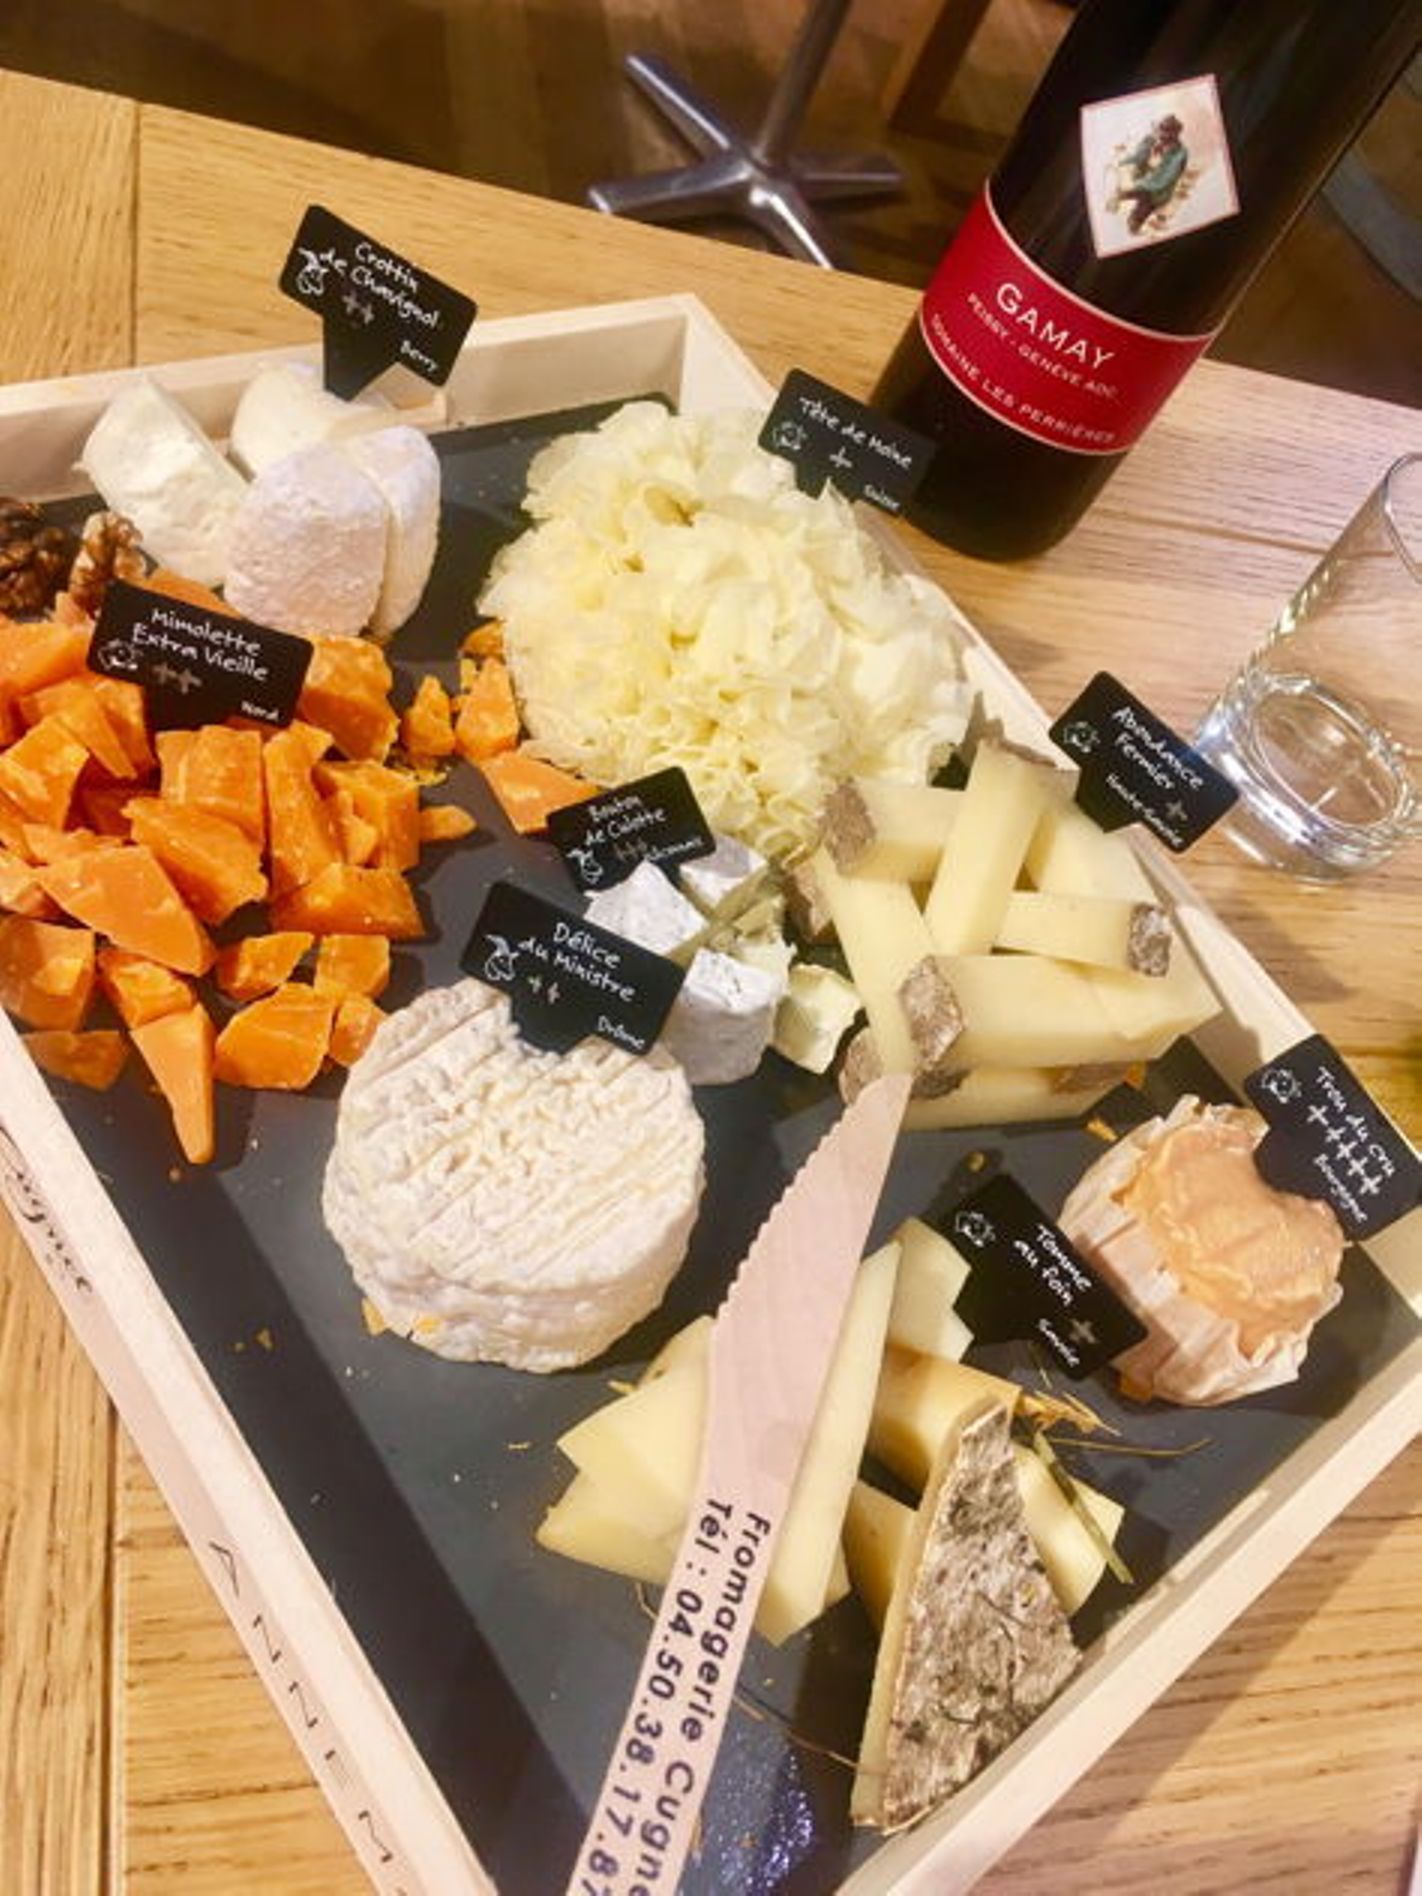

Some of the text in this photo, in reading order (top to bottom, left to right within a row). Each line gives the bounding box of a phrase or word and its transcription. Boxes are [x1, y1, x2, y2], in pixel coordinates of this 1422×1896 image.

[930, 312, 980, 382] DOMAINE
[981, 378, 1017, 409] LES
[997, 282, 1115, 370] GAMAY
[132, 622, 269, 682] Extra Vieille
[152, 608, 262, 657] Mimolette
[518, 936, 635, 1002] du Ministre
[553, 922, 621, 969] Délice
[1316, 1066, 1347, 1113] Trou
[1345, 1114, 1370, 1142] du
[680, 1510, 772, 1744] Fromagerie
[582, 1589, 702, 1896] 04.50.38.17.87
